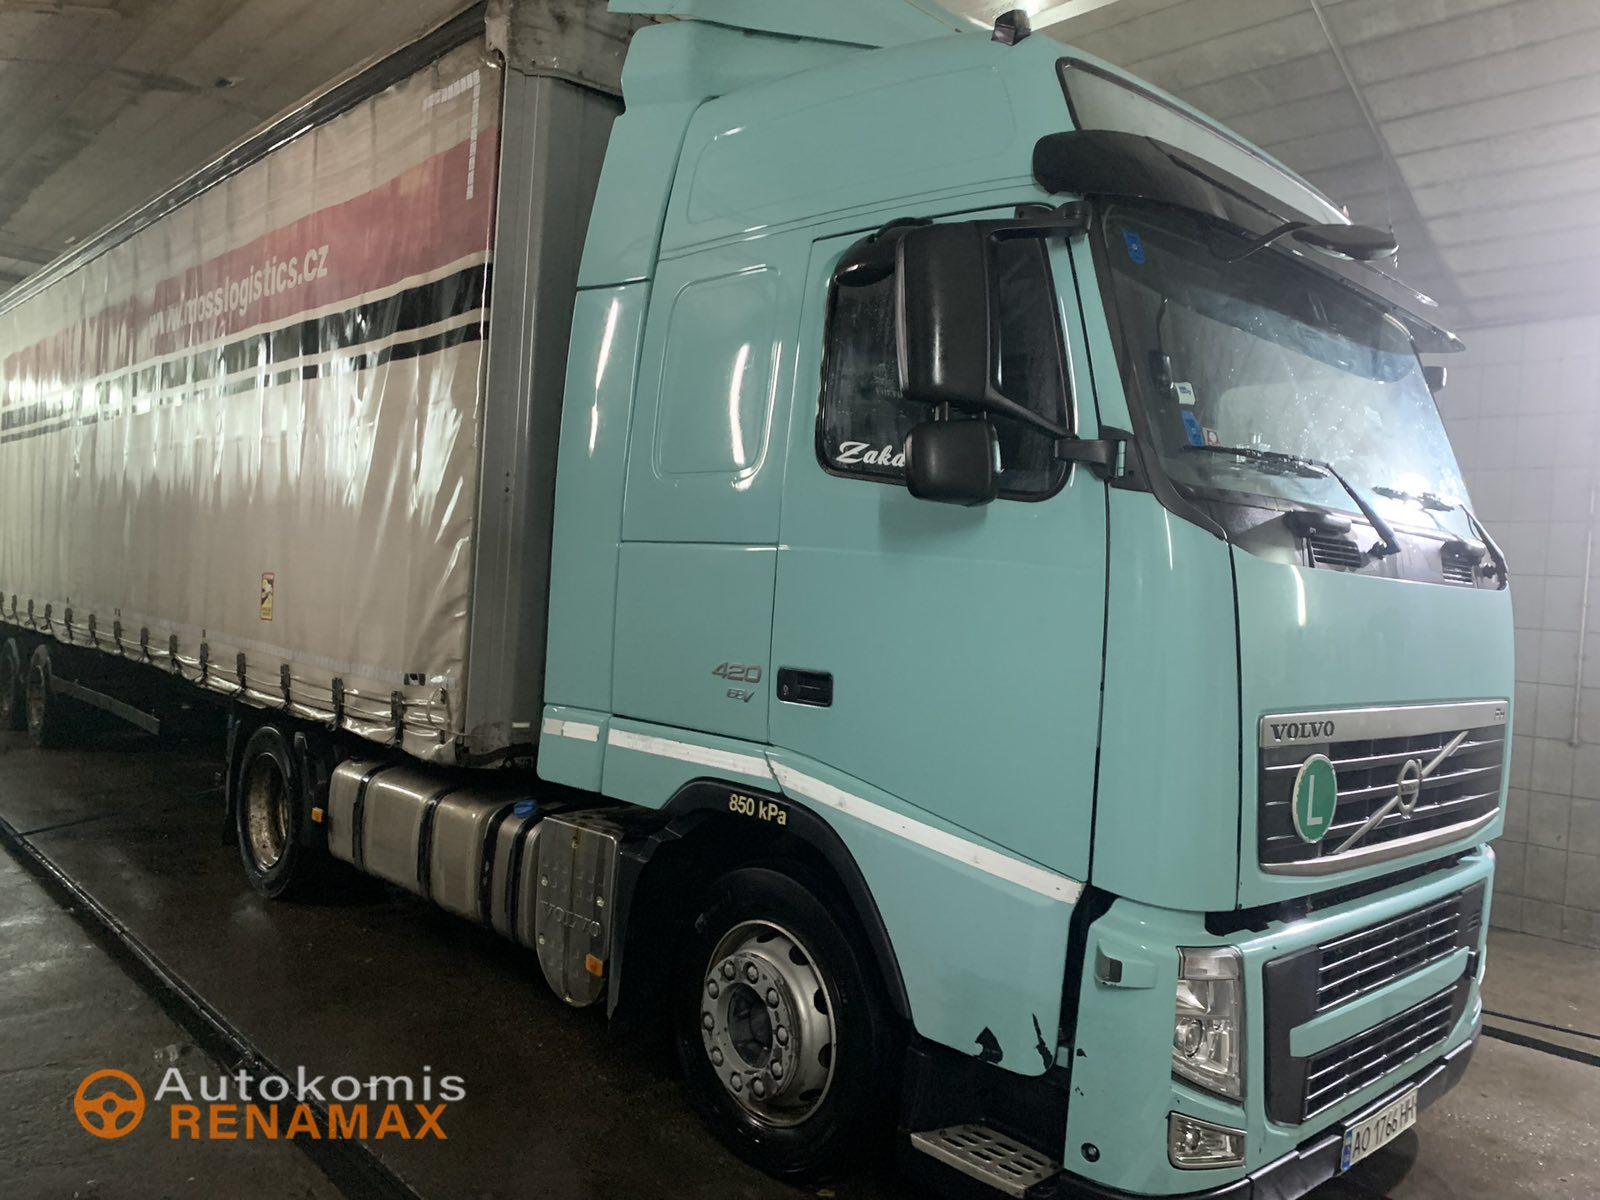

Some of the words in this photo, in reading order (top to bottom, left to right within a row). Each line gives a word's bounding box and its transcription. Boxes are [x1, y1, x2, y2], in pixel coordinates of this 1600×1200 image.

[712, 662, 762, 684] 420
[1270, 720, 1335, 741] VOLVO
[729, 793, 755, 817] 850
[758, 800, 787, 826] kPa
[1306, 774, 1324, 826] L
[1373, 1106, 1399, 1146] 1766
